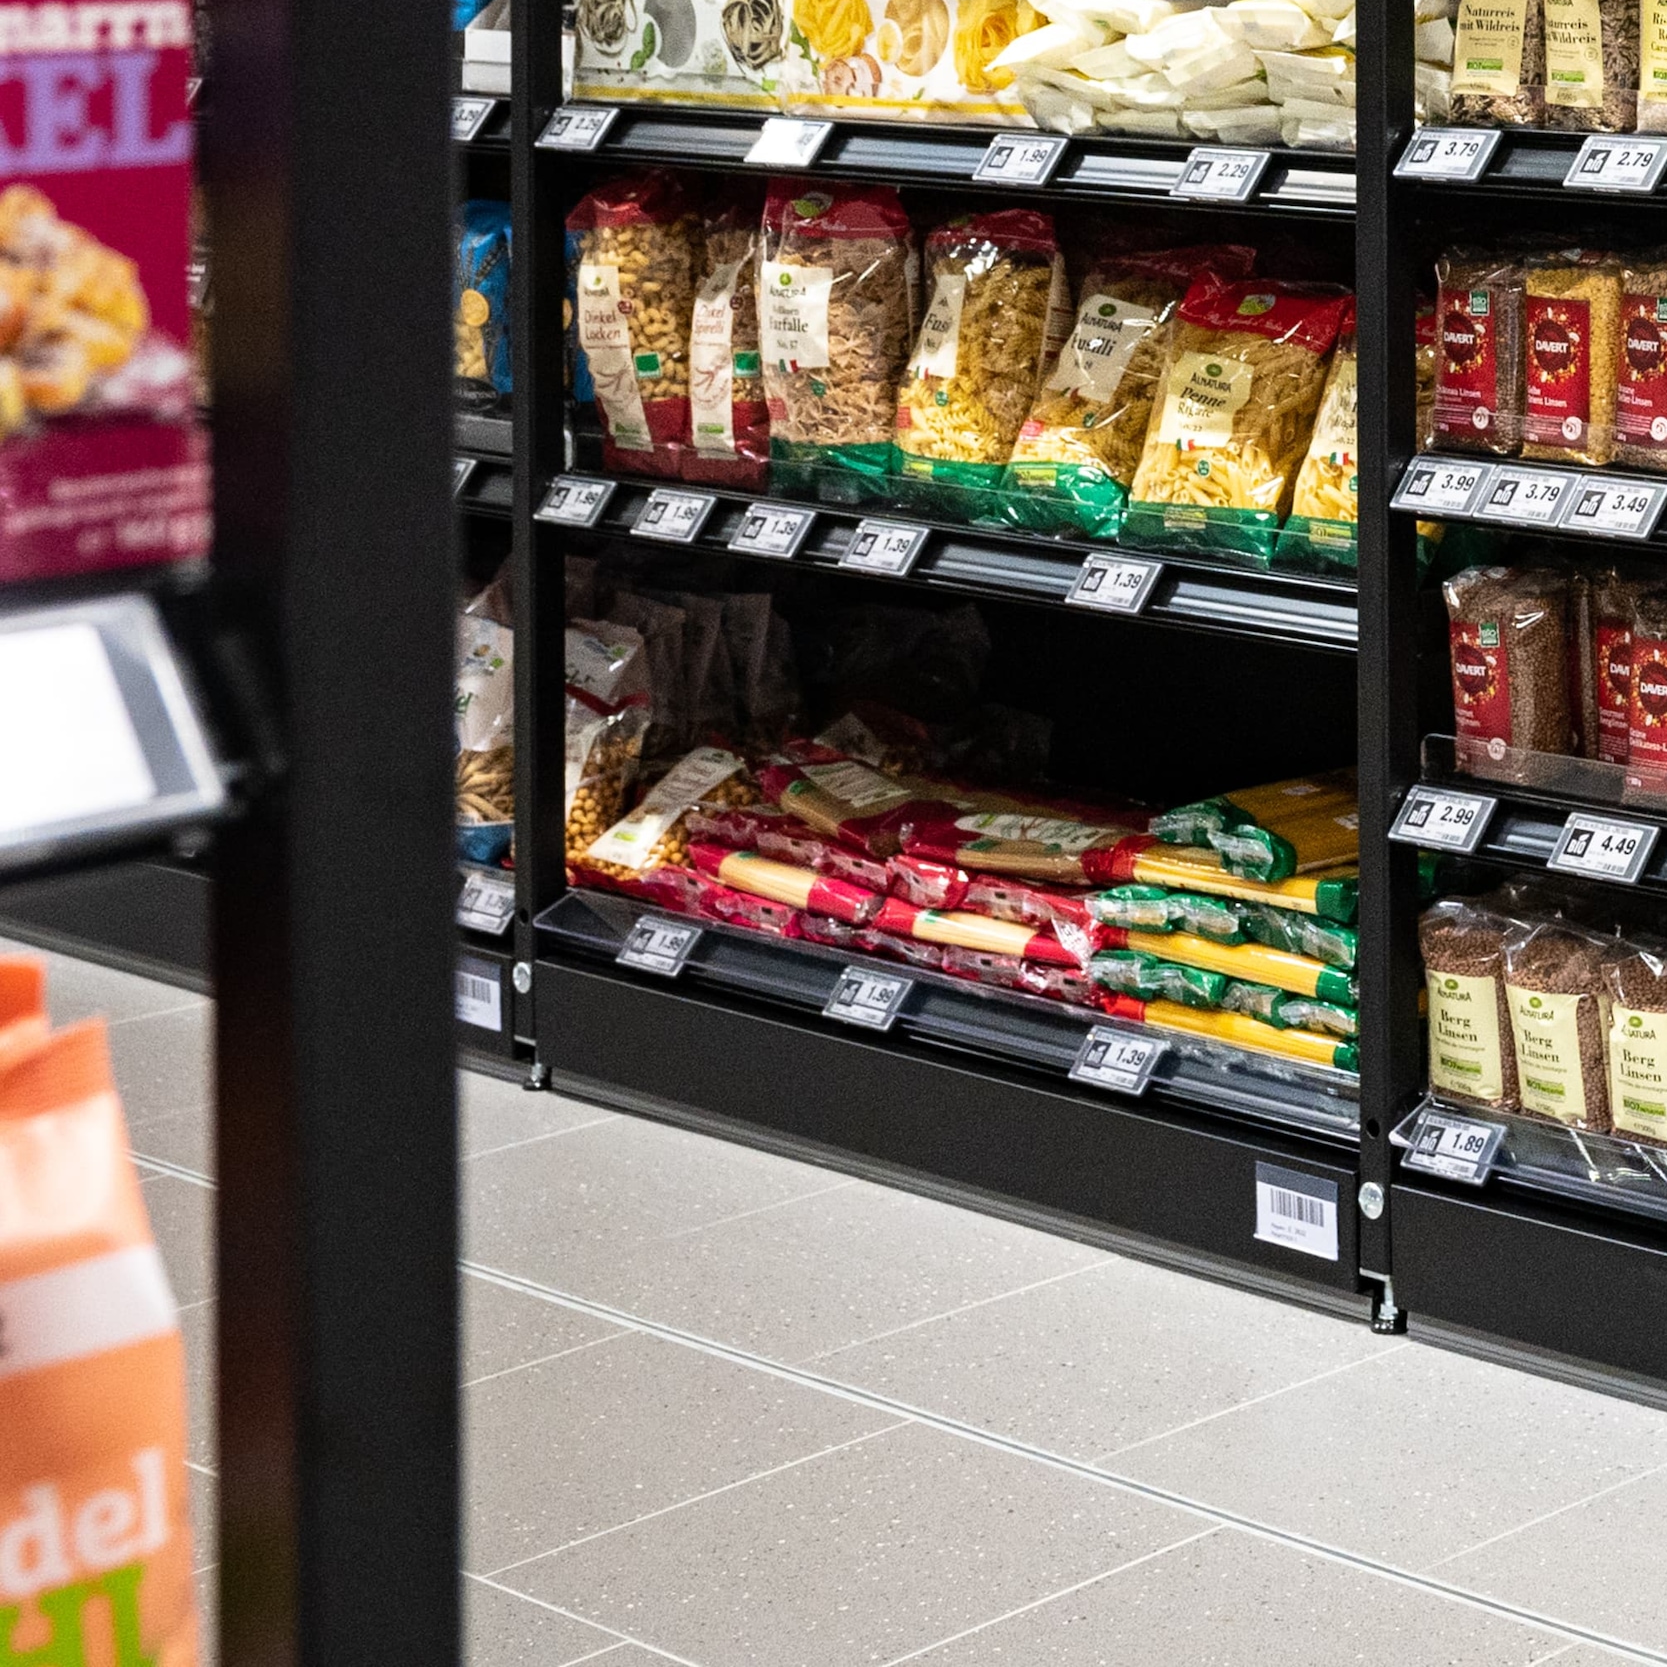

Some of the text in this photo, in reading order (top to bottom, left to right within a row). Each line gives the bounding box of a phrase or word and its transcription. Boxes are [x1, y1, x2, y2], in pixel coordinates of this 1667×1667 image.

[1443, 140, 1480, 160] 3.79
[1216, 162, 1251, 181] 2.29
[1524, 483, 1561, 503] 3.79
[1113, 572, 1144, 593] 1.39
[1624, 1049, 1655, 1068] Berg
[1620, 1065, 1662, 1083] Linsen
